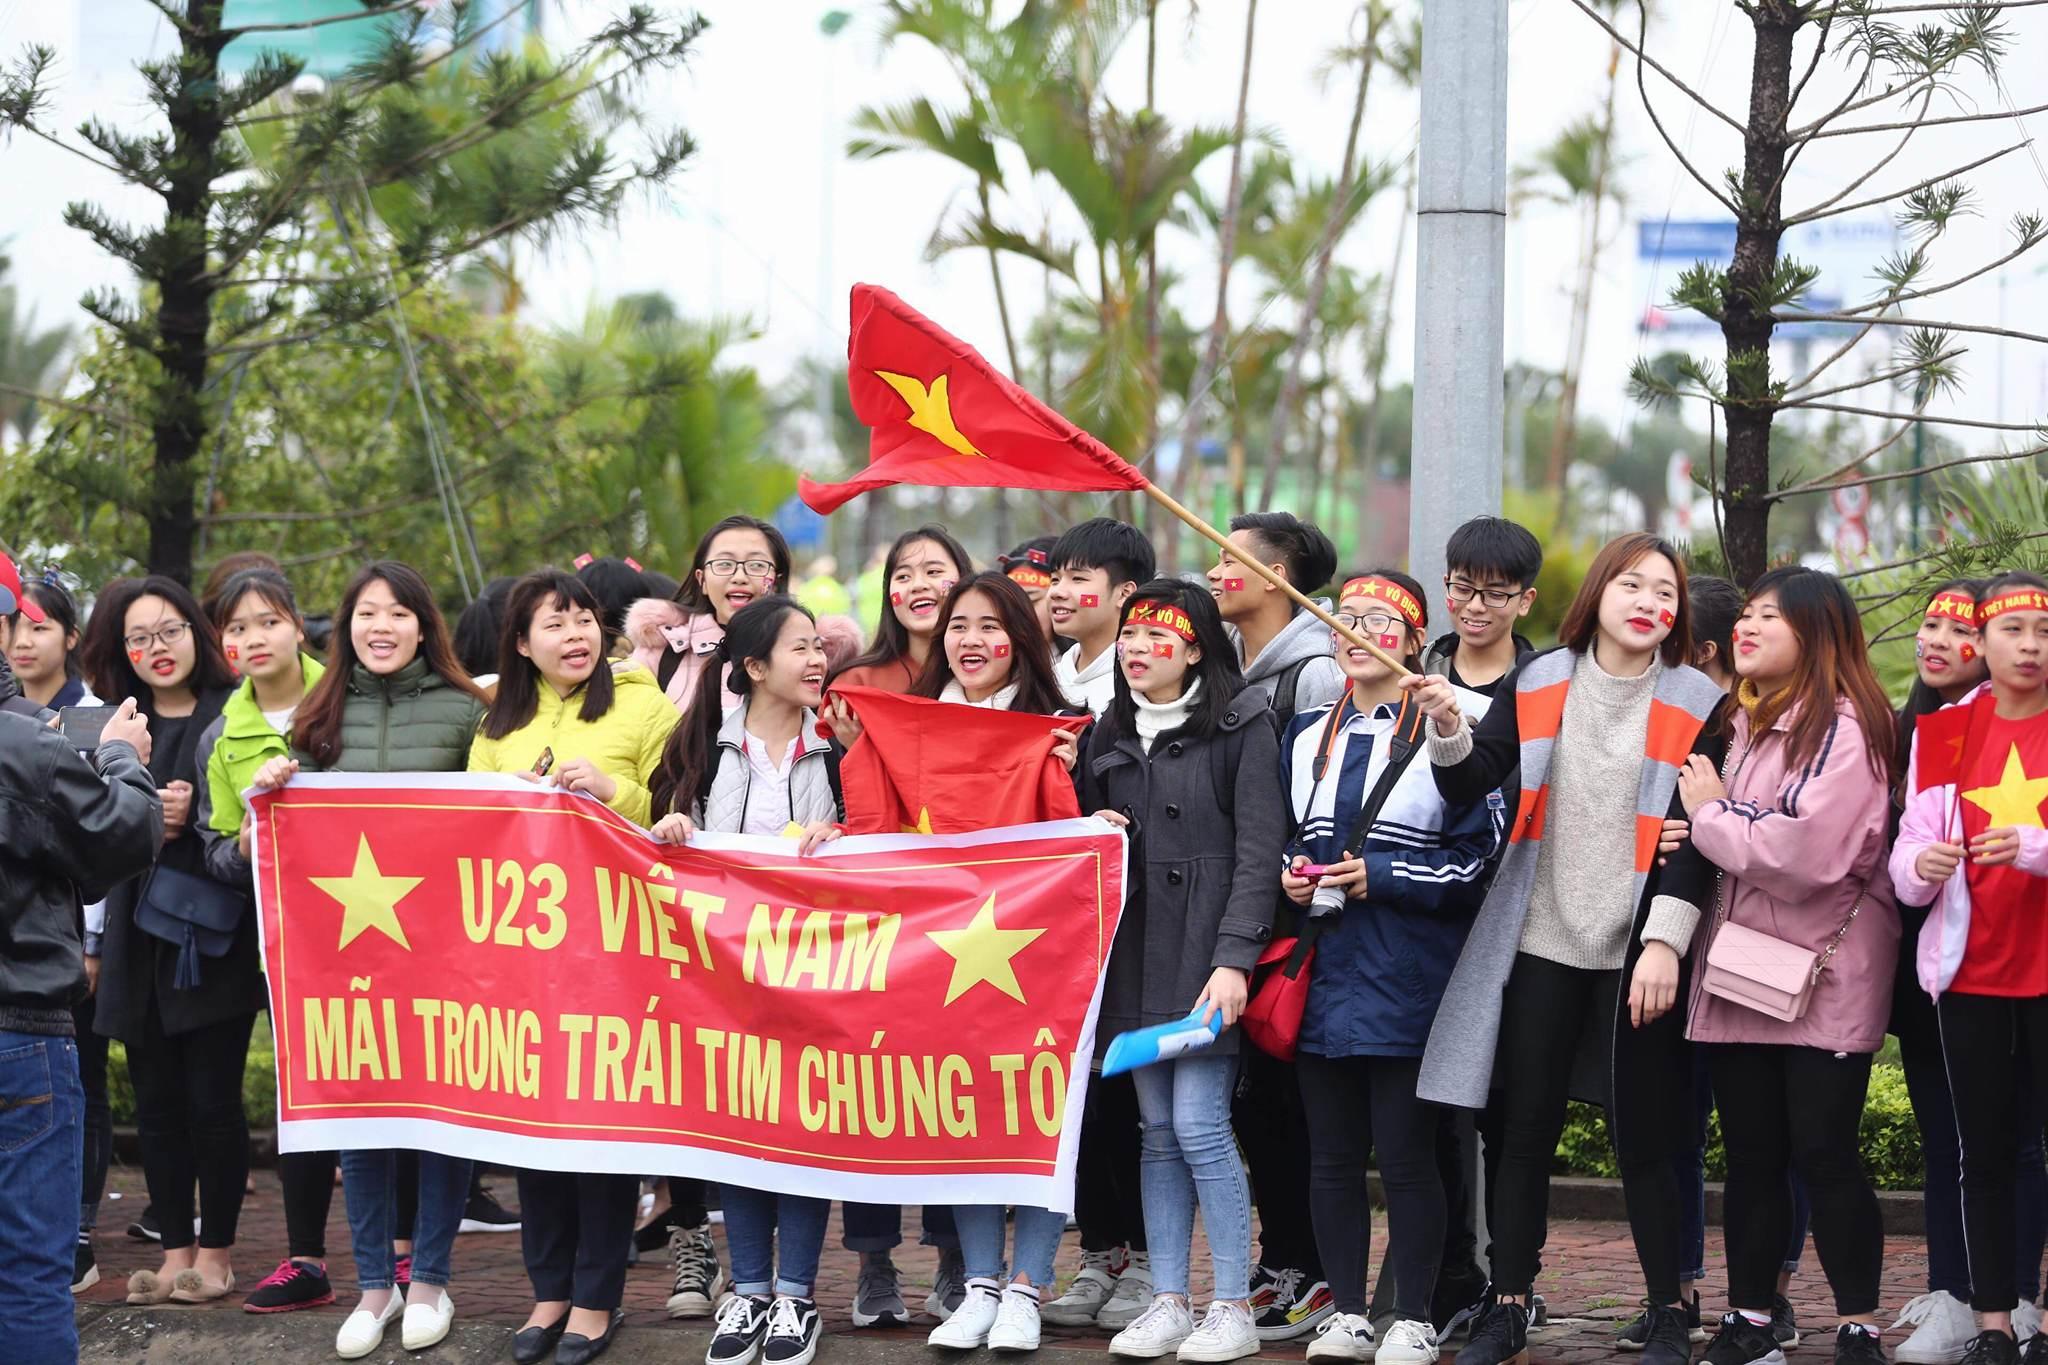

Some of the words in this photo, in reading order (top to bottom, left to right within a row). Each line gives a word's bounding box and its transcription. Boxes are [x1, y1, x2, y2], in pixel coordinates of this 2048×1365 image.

[1385, 587, 1401, 601] VÔ
[2005, 595, 2031, 609] NAM
[1956, 602, 1974, 619] VÔ
[1157, 609, 1173, 624] VÔ
[1175, 615, 1196, 636] ĐỊC
[457, 857, 568, 950] U23
[594, 862, 725, 979] VIỆT
[742, 903, 902, 992] NAM
[303, 975, 402, 1081] MÃI
[412, 998, 542, 1099] TRONG
[559, 995, 682, 1106] TRÁI
[695, 1027, 782, 1125] TIM
[798, 1030, 978, 1138] CHÚNG
[990, 1028, 1077, 1138] TÔ
